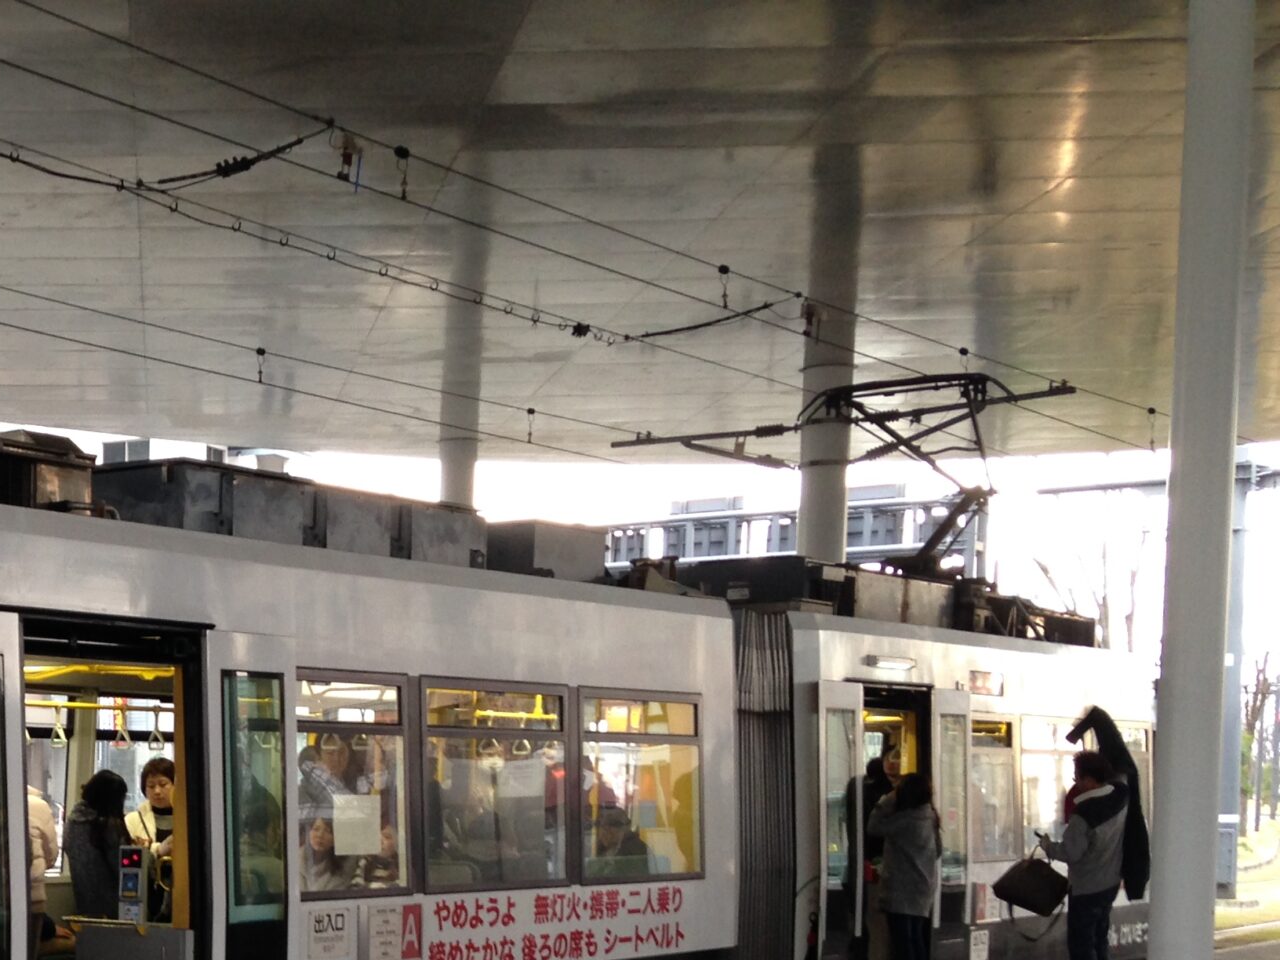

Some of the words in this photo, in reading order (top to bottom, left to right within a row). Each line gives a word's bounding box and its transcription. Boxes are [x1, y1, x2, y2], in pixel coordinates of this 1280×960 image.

[314, 913, 345, 934] 出入口
[433, 896, 516, 932] やめようよ
[533, 886, 683, 925] 無灯火・携帯・二人乗り
[403, 912, 420, 952] A
[604, 922, 685, 955] シートベルト
